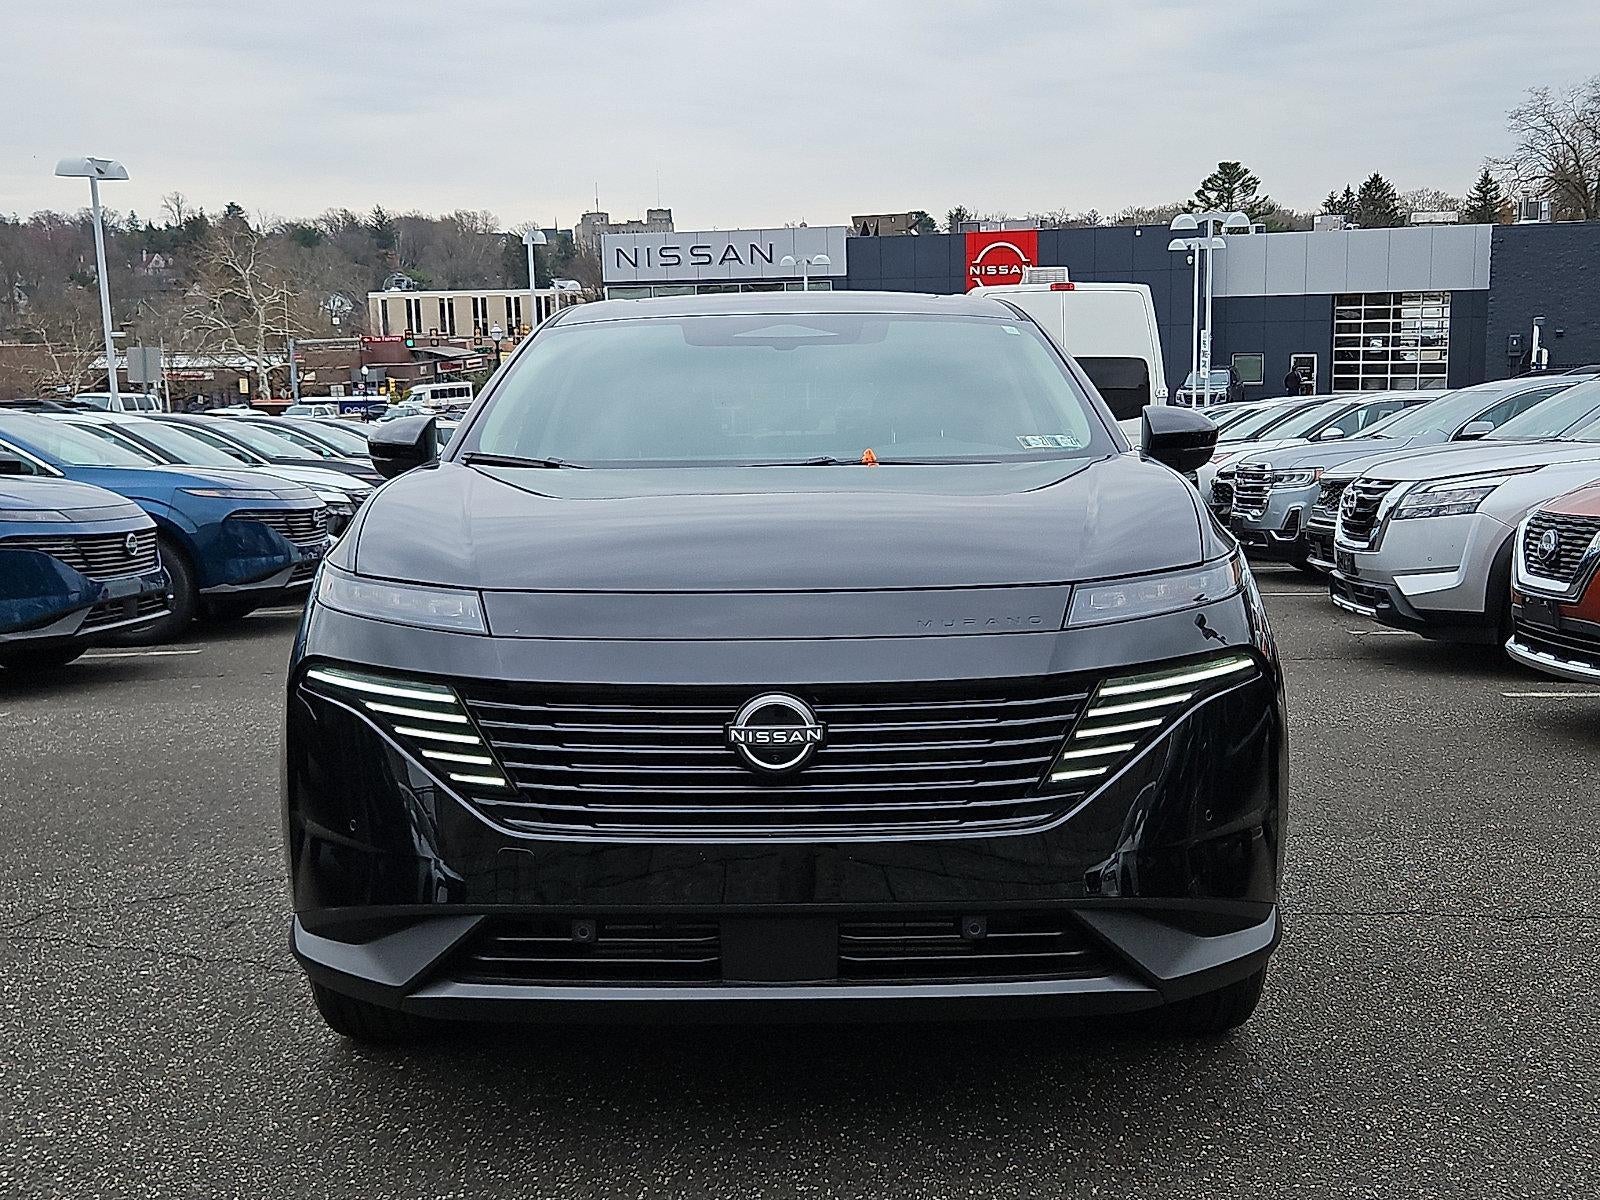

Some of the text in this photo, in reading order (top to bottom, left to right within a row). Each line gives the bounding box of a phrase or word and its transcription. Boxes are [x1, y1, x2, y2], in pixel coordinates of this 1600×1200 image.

[615, 242, 774, 268] NISSAN
[917, 615, 1042, 627] MURANO
[730, 728, 821, 743] NISSAN
